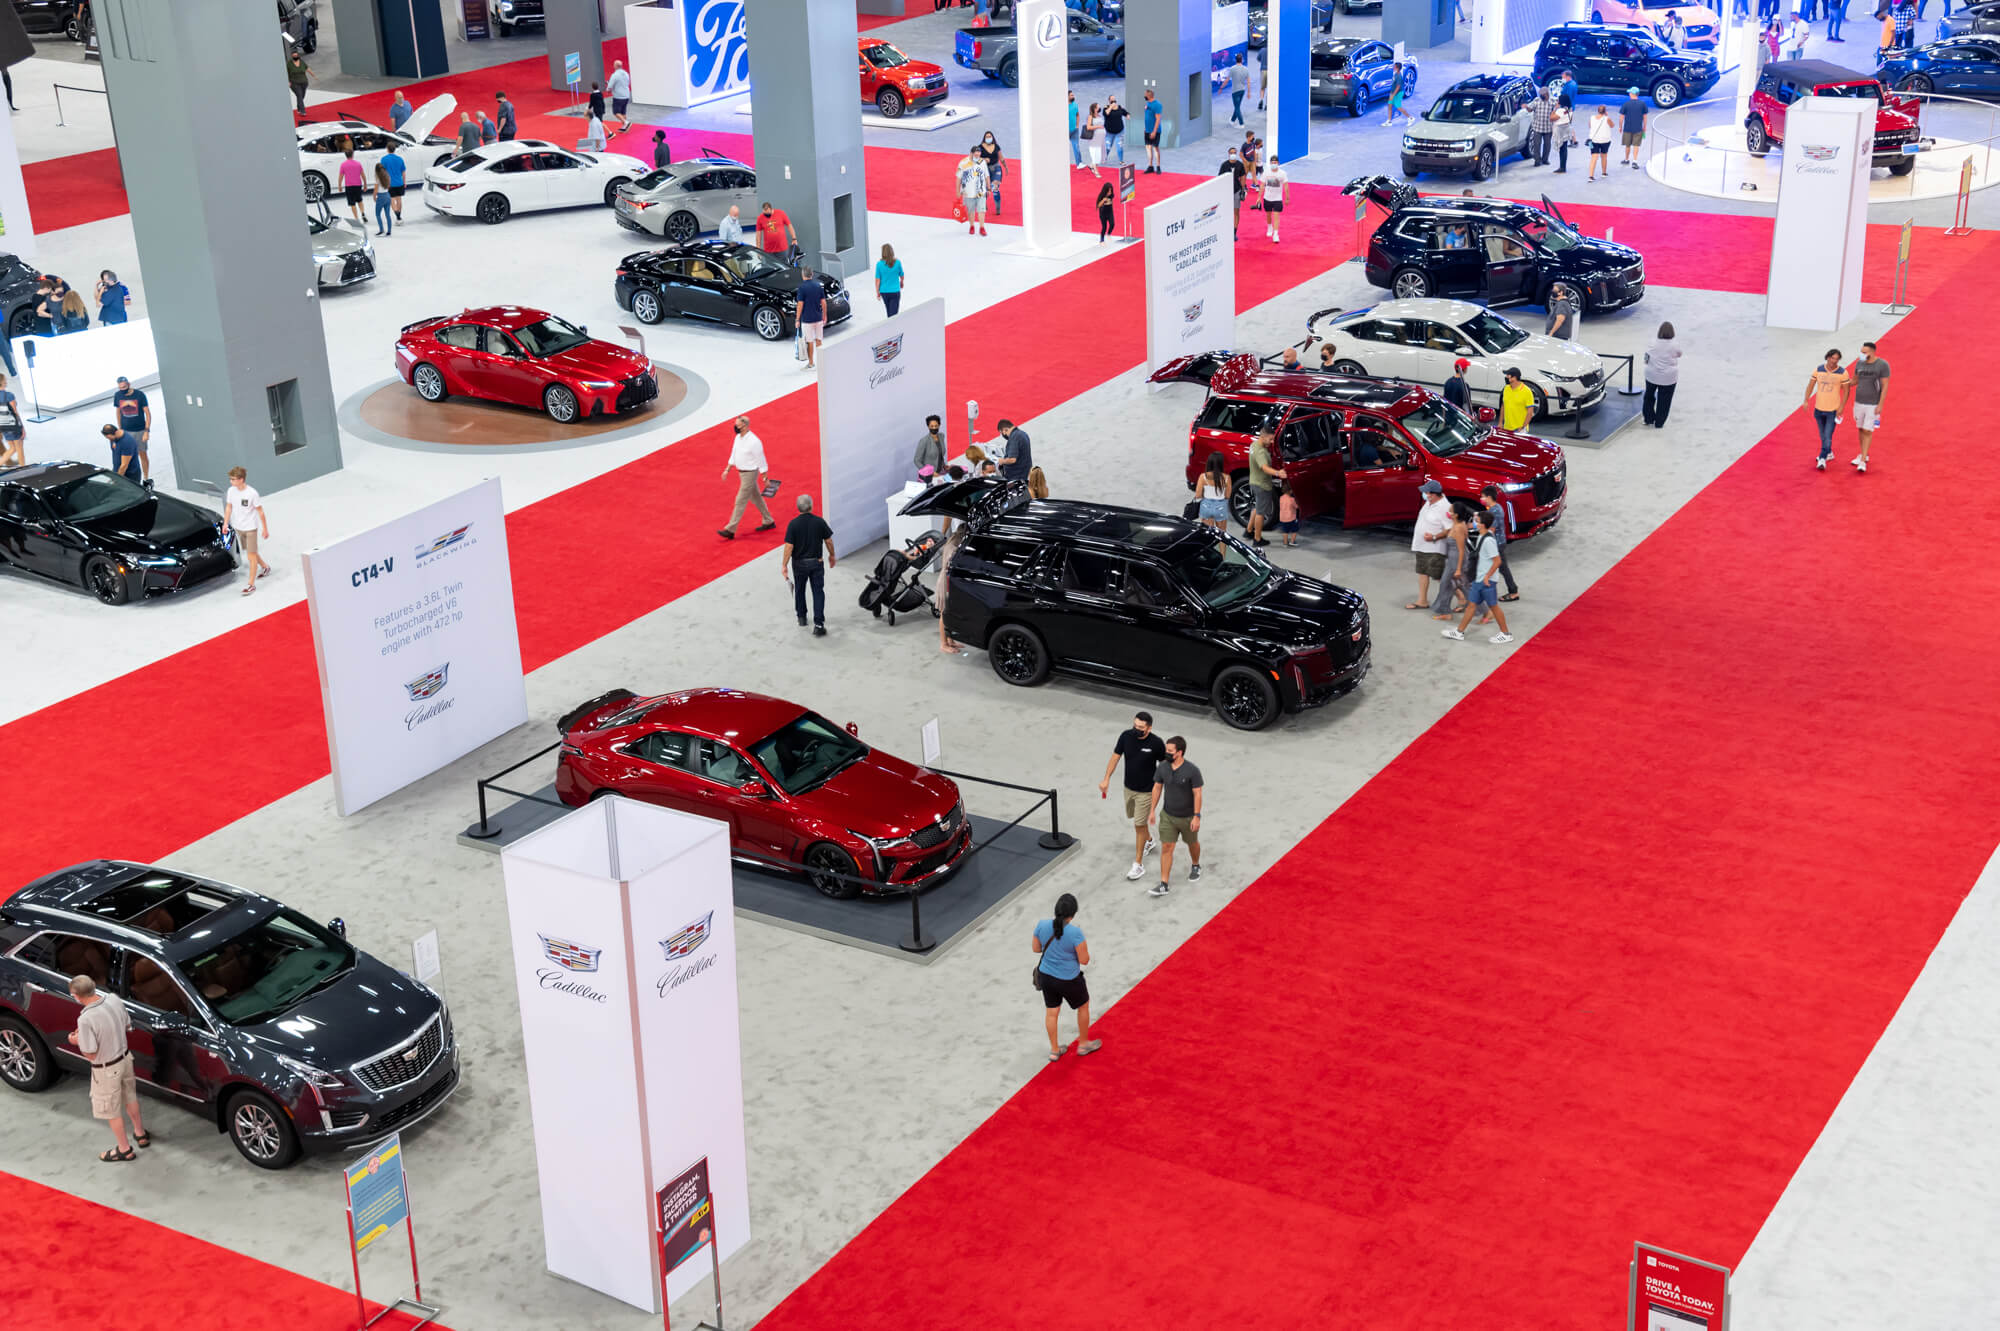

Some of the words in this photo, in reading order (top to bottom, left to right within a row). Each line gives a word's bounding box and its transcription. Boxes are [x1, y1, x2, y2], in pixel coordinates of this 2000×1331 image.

[1166, 219, 1185, 237] CT5-V
[1168, 250, 1178, 263] THE
[1179, 245, 1192, 258] MOST
[1193, 234, 1218, 253] POWERFUL
[1175, 254, 1198, 272] CADILLAC
[1199, 248, 1212, 262] EVER
[869, 365, 904, 390] Cadillac
[416, 537, 478, 569] BLACKWING
[351, 556, 394, 588] CT4-V
[374, 604, 414, 628] Features
[416, 600, 422, 610] a
[423, 590, 441, 606] 3.6L
[443, 581, 463, 596] Twin
[383, 602, 443, 639] Turbocharged
[445, 596, 457, 610] V6
[381, 635, 411, 656] engine
[413, 624, 432, 641] with
[434, 615, 450, 630] 472
[451, 610, 463, 623] hp
[404, 697, 454, 731] Cadillac
[536, 967, 607, 1004] Cadillac
[656, 953, 717, 999] Cadillac
[663, 1173, 700, 1214] INSTAGRAM,
[664, 1183, 697, 1222] FACEBOOK
[670, 1192, 697, 1224] TWITTER
[1658, 1261, 1680, 1272] TOYOTA
[1646, 1276, 1672, 1290] DRIVE
[1646, 1284, 1680, 1300] TOYOTA
[1682, 1295, 1714, 1311] TODAY.
